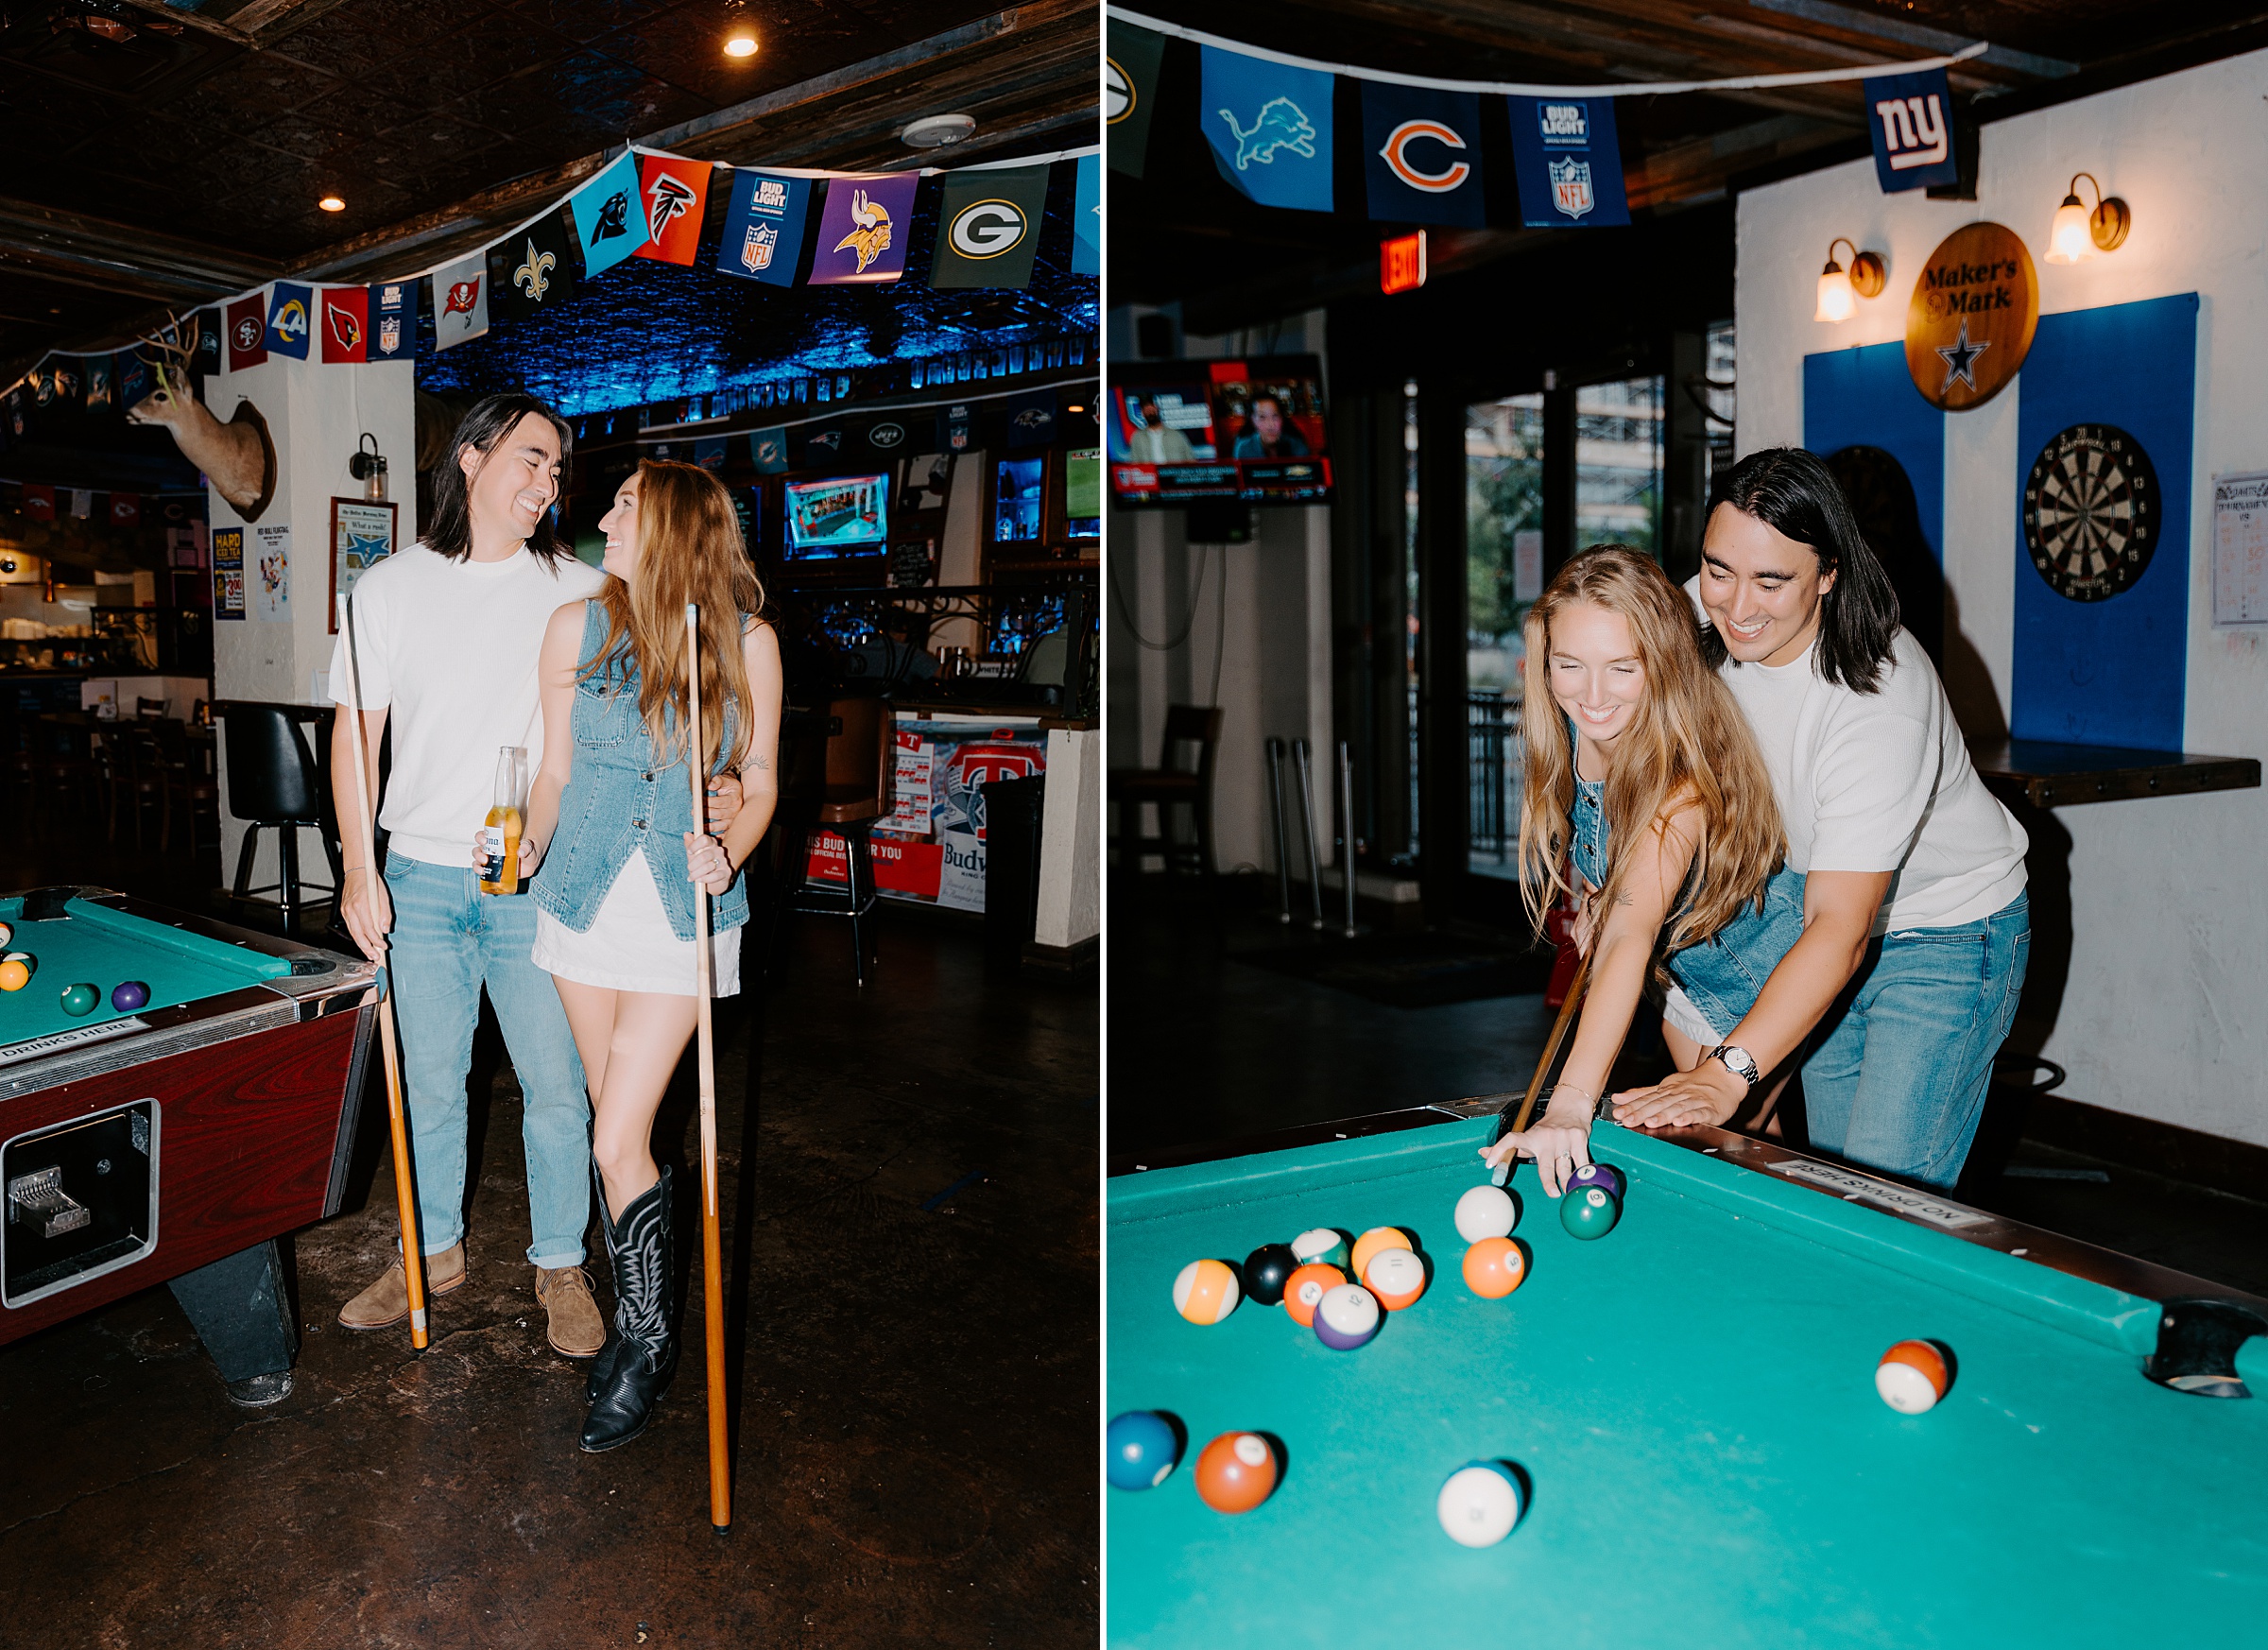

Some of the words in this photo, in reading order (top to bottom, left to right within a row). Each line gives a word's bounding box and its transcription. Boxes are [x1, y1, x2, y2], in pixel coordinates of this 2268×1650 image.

[1546, 105, 1579, 120] BUD
[1541, 118, 1586, 134] LIGHT
[1379, 119, 1469, 193] C
[760, 180, 783, 196] BUD
[753, 191, 786, 207] LIGHT
[1557, 184, 1589, 209] NFL
[954, 204, 1021, 254] G
[746, 243, 767, 265] NFL
[1926, 259, 2017, 291] Maker's
[385, 286, 399, 297] BUD
[382, 295, 403, 305] LIGHT
[1945, 285, 2011, 316] Mark
[271, 307, 307, 335] LA
[382, 333, 398, 347] NFL
[2077, 427, 2088, 439] 20
[2097, 427, 2103, 438] 1
[952, 436, 966, 447] NFL
[2044, 447, 2053, 461] 12
[2034, 466, 2041, 479] 9
[2134, 477, 2145, 490] 13
[2136, 526, 2147, 540] 10
[215, 533, 241, 548] HARD
[216, 548, 227, 557] ICED
[2128, 550, 2139, 562] 15
[2118, 568, 2125, 581] 2
[907, 734, 919, 748] T
[814, 849, 835, 859] OFFICIAL
[823, 836, 845, 851] BUD
[881, 846, 902, 860] YOU
[961, 871, 979, 880] KING
[2, 1034, 77, 1057] DRINKS
[80, 1022, 133, 1038] HERE
[1789, 1162, 1845, 1181] HERE
[1844, 1180, 1924, 1207] DRINKS
[1923, 1206, 1961, 1220] NO
[1390, 1259, 1402, 1267] 11
[1510, 1257, 1519, 1266] 5
[1348, 1294, 1363, 1307] 12
